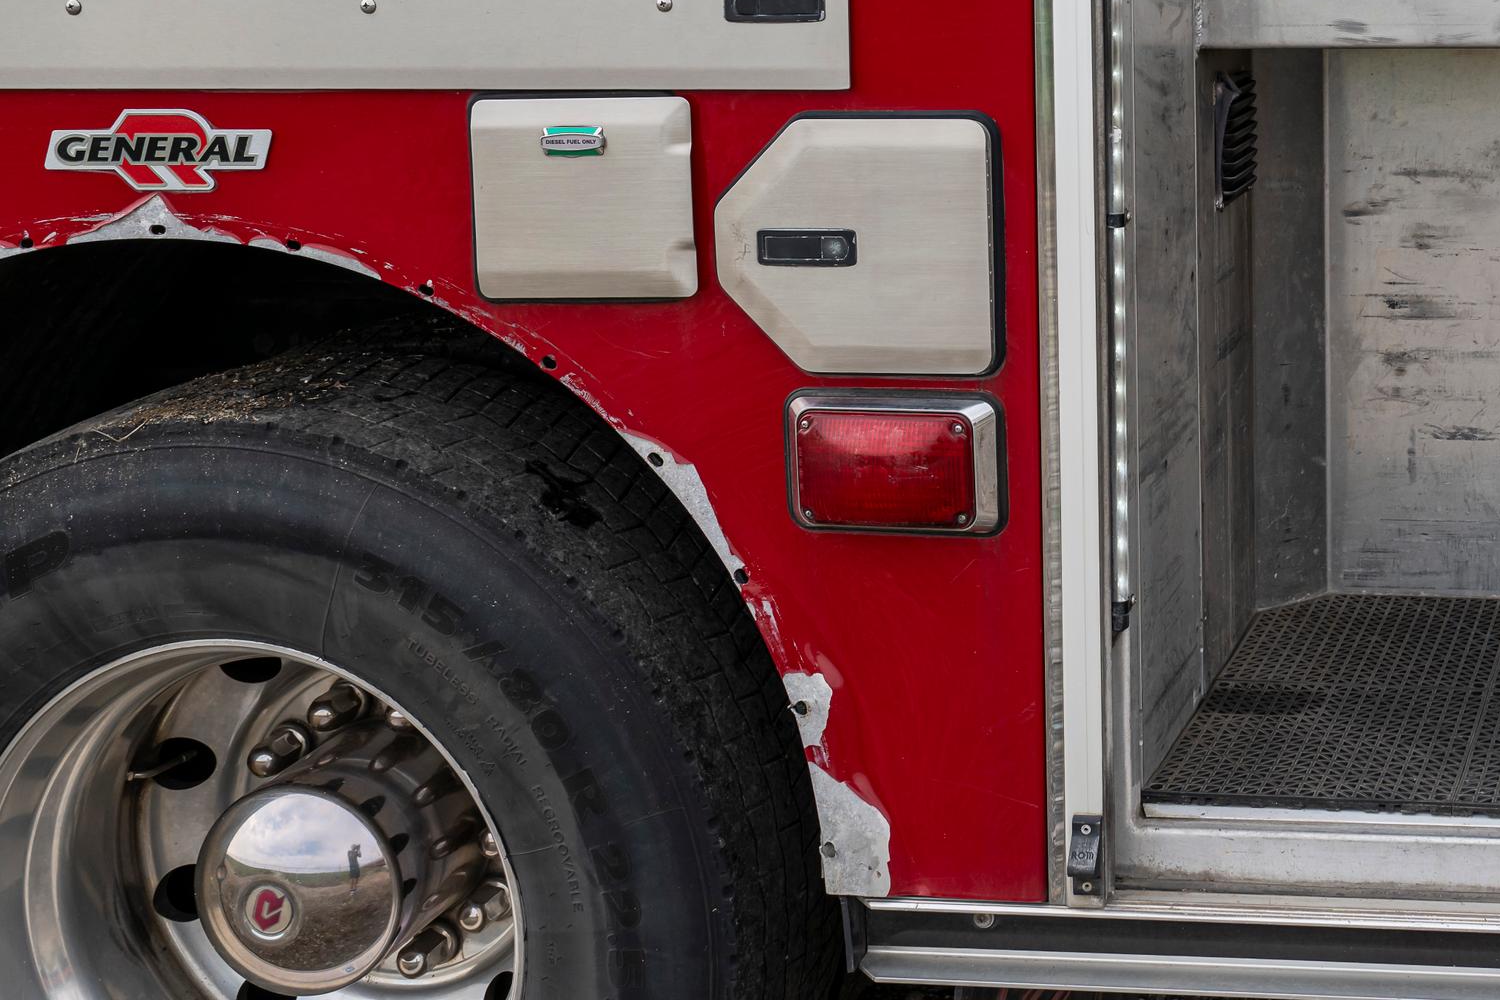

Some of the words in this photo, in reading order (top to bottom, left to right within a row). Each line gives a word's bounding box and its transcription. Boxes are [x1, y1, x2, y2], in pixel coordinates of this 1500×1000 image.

[56, 134, 257, 165] GENERAL
[406, 637, 480, 705] TUBELESS
[484, 714, 529, 771] RADIAL
[531, 784, 584, 912] REGROOVABLE
